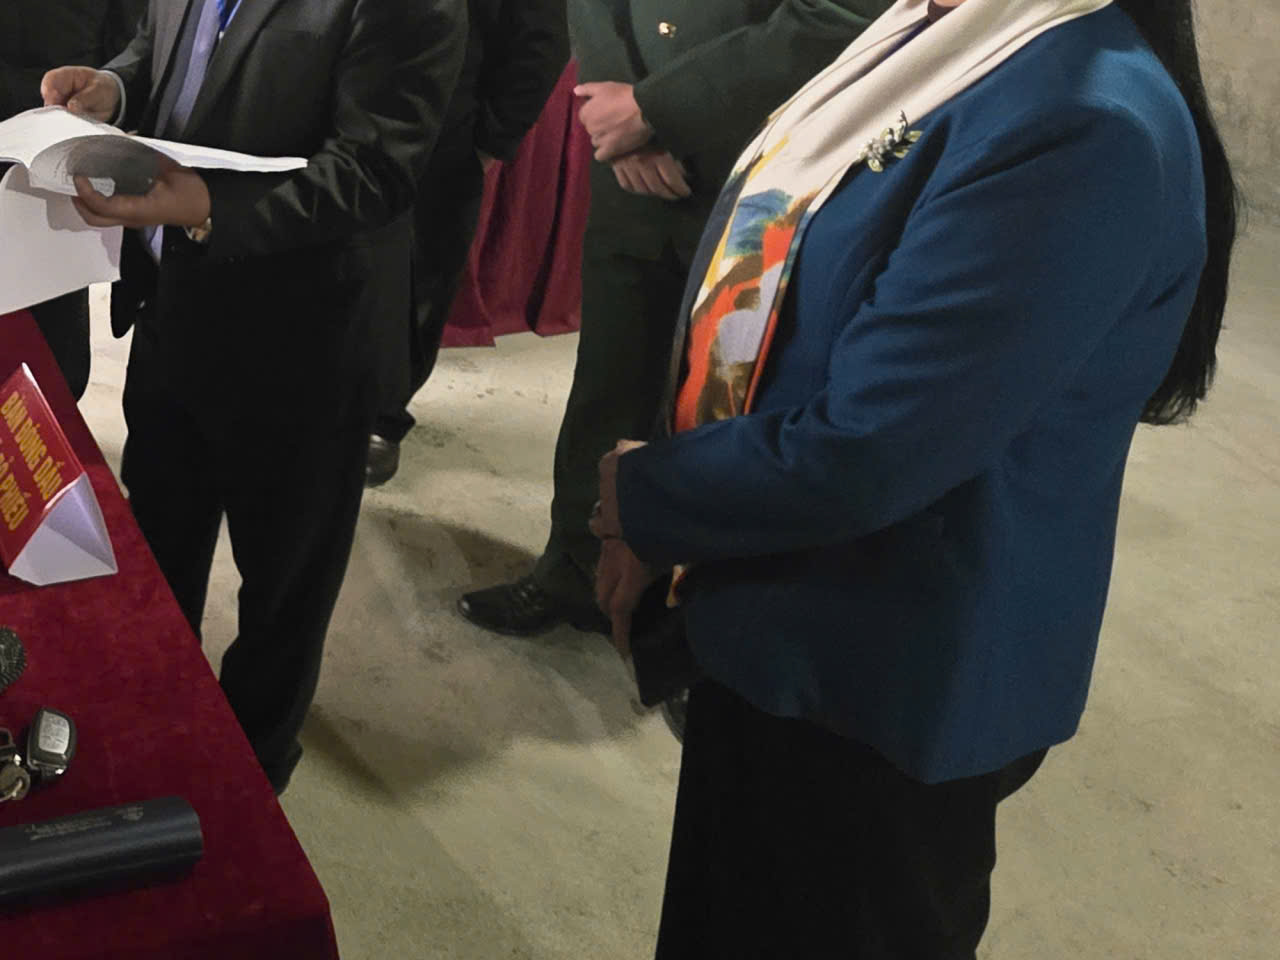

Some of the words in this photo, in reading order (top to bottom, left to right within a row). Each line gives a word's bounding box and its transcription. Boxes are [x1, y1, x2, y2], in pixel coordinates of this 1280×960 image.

[0, 391, 27, 433] BÀN
[13, 417, 47, 471] ĐÓNG
[32, 455, 65, 501] DẤU
